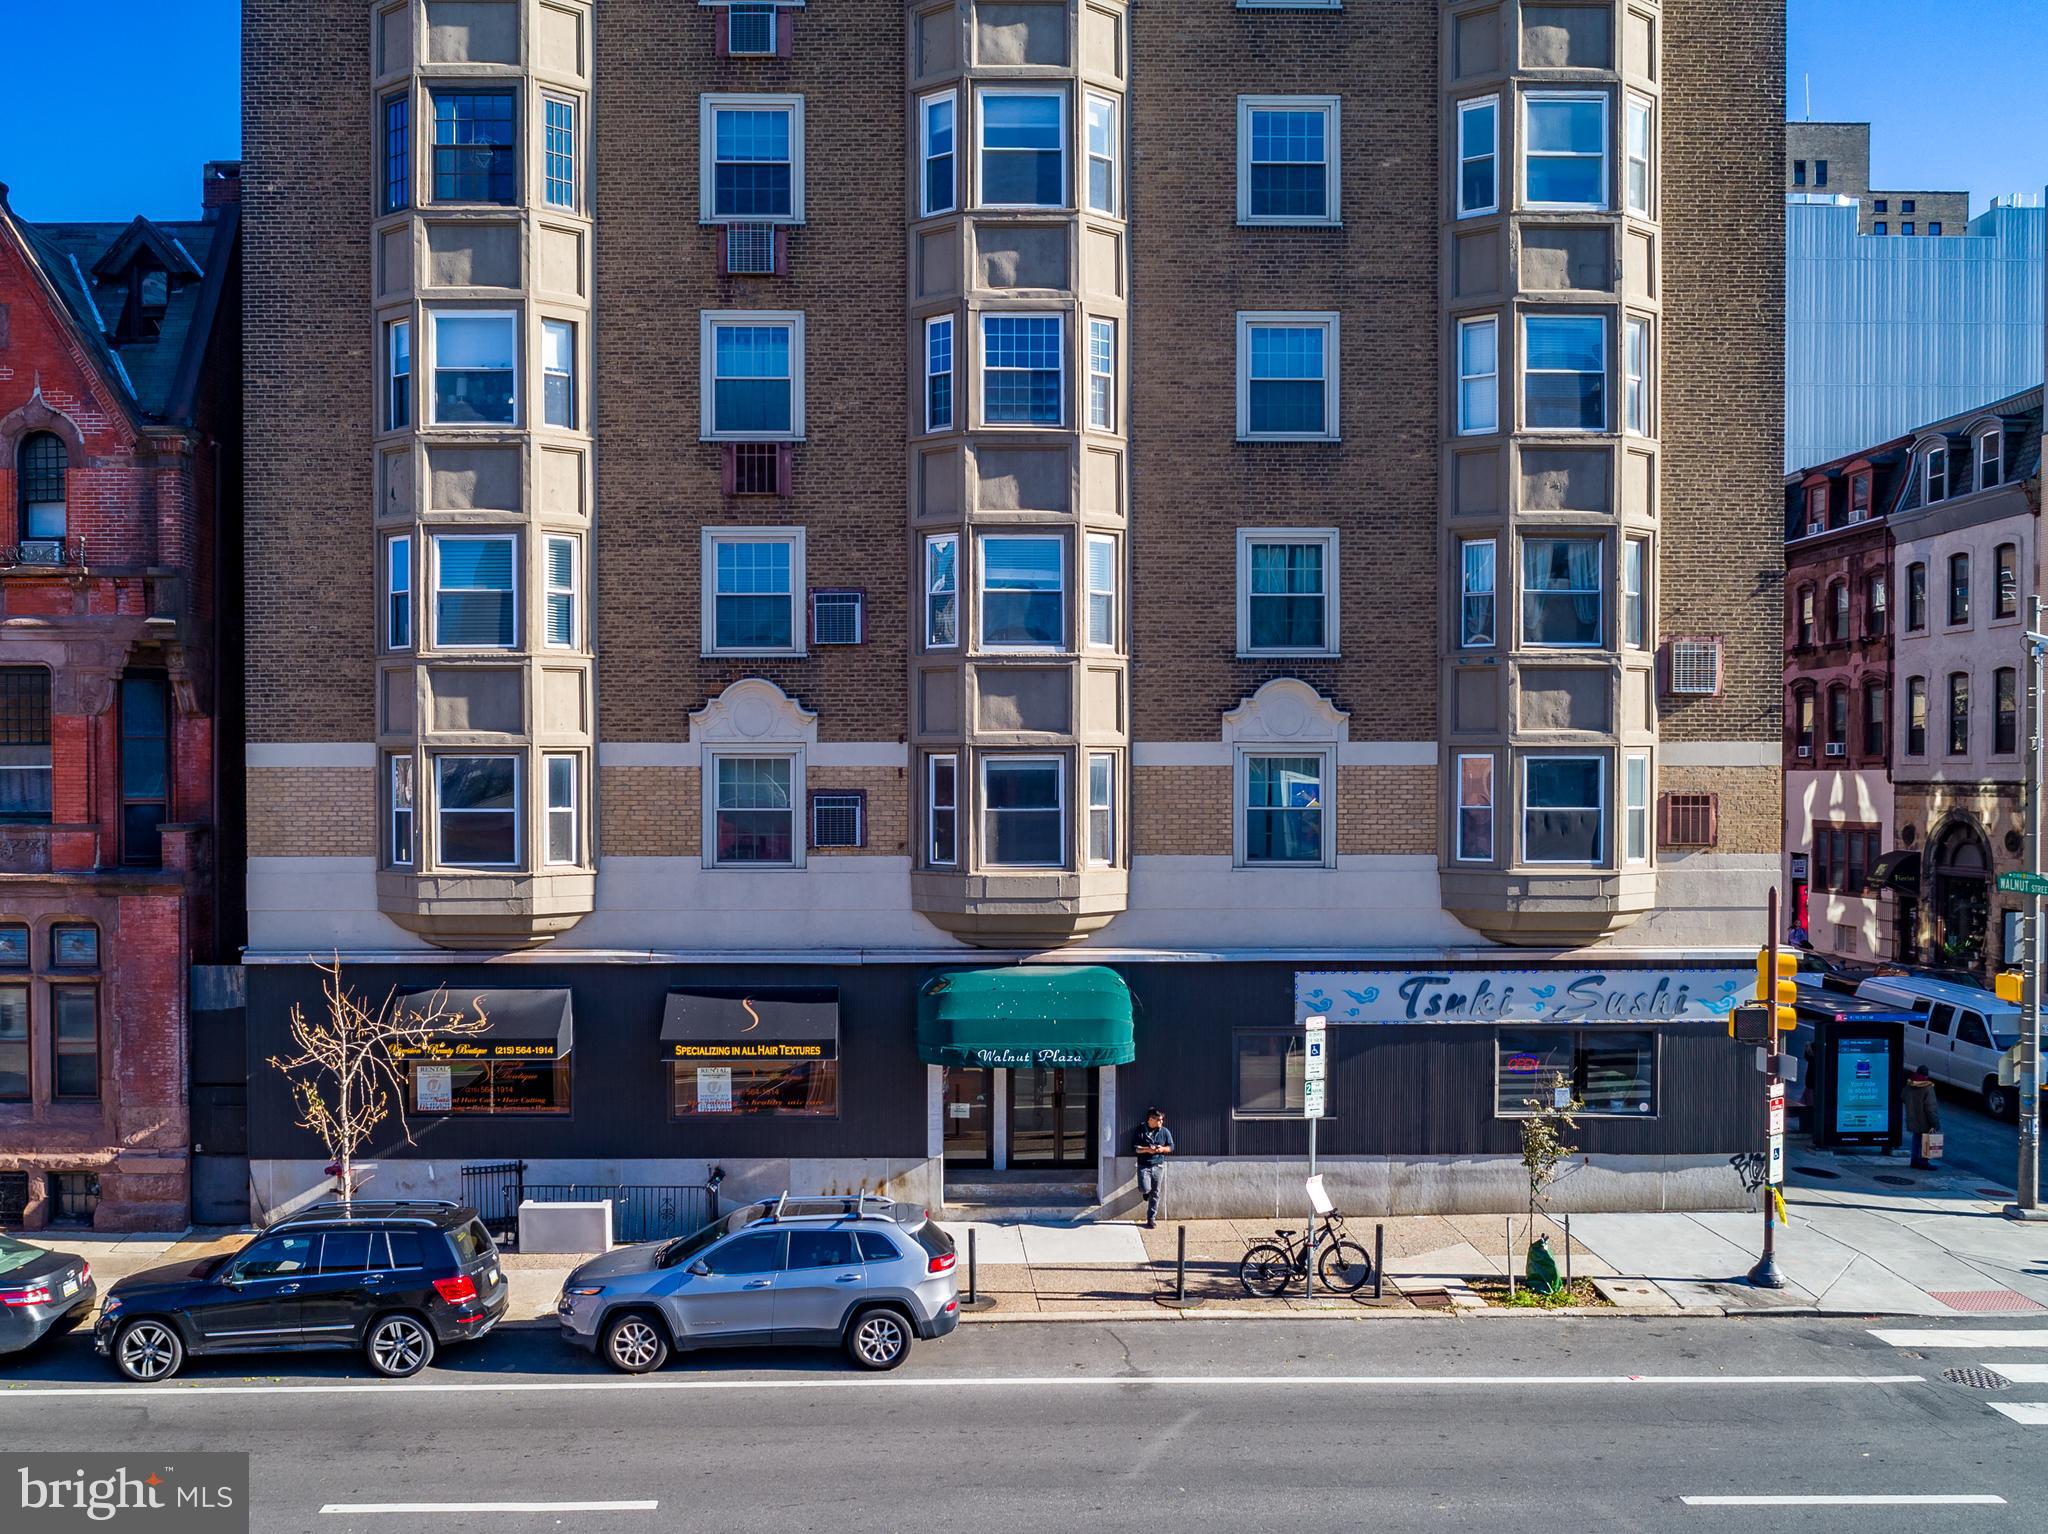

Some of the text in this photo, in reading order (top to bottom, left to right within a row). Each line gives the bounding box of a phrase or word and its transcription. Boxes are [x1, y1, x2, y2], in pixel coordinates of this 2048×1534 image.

[2000, 878, 2048, 894] WALNUT STREE
[1399, 975, 1690, 1019] Tsuki Sushi
[429, 1043, 454, 1057] Beauty
[456, 1043, 488, 1057] Boutique
[495, 1046, 514, 1055] (215)
[515, 1046, 553, 1054] 564-1914
[977, 1049, 1082, 1062] Walnut Plaza
[1508, 1058, 1539, 1070] OPEN
[1306, 1083, 1312, 1095] 2
